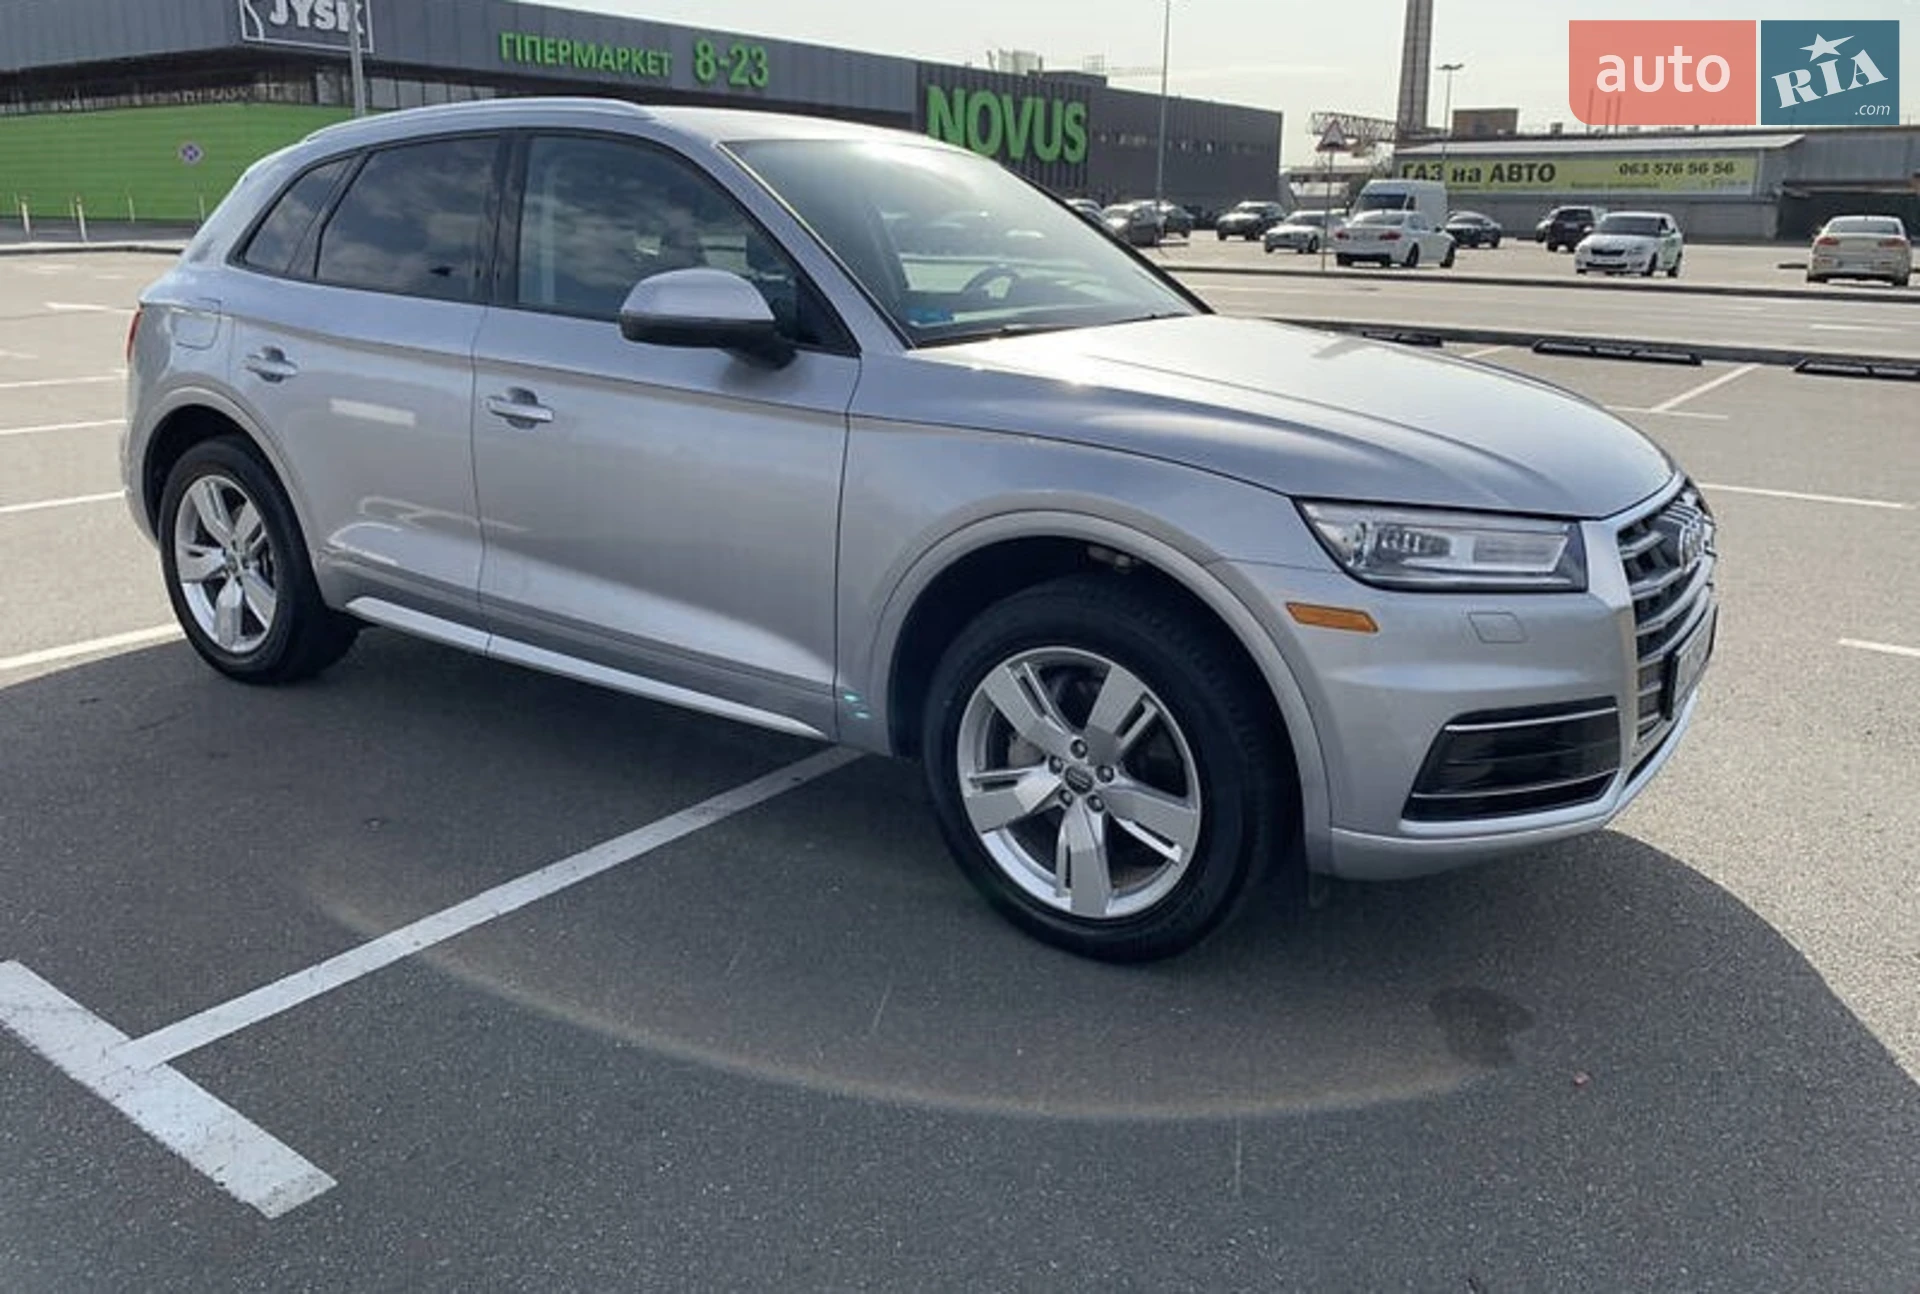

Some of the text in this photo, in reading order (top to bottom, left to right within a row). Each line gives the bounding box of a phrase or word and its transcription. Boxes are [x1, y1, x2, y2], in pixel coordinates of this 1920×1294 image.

[499, 32, 769, 88] ГІПЕРМАРКЕТ 8-23
[925, 85, 1088, 163] NOVUS
[1402, 162, 1556, 183] ГАЗ на АВТО
